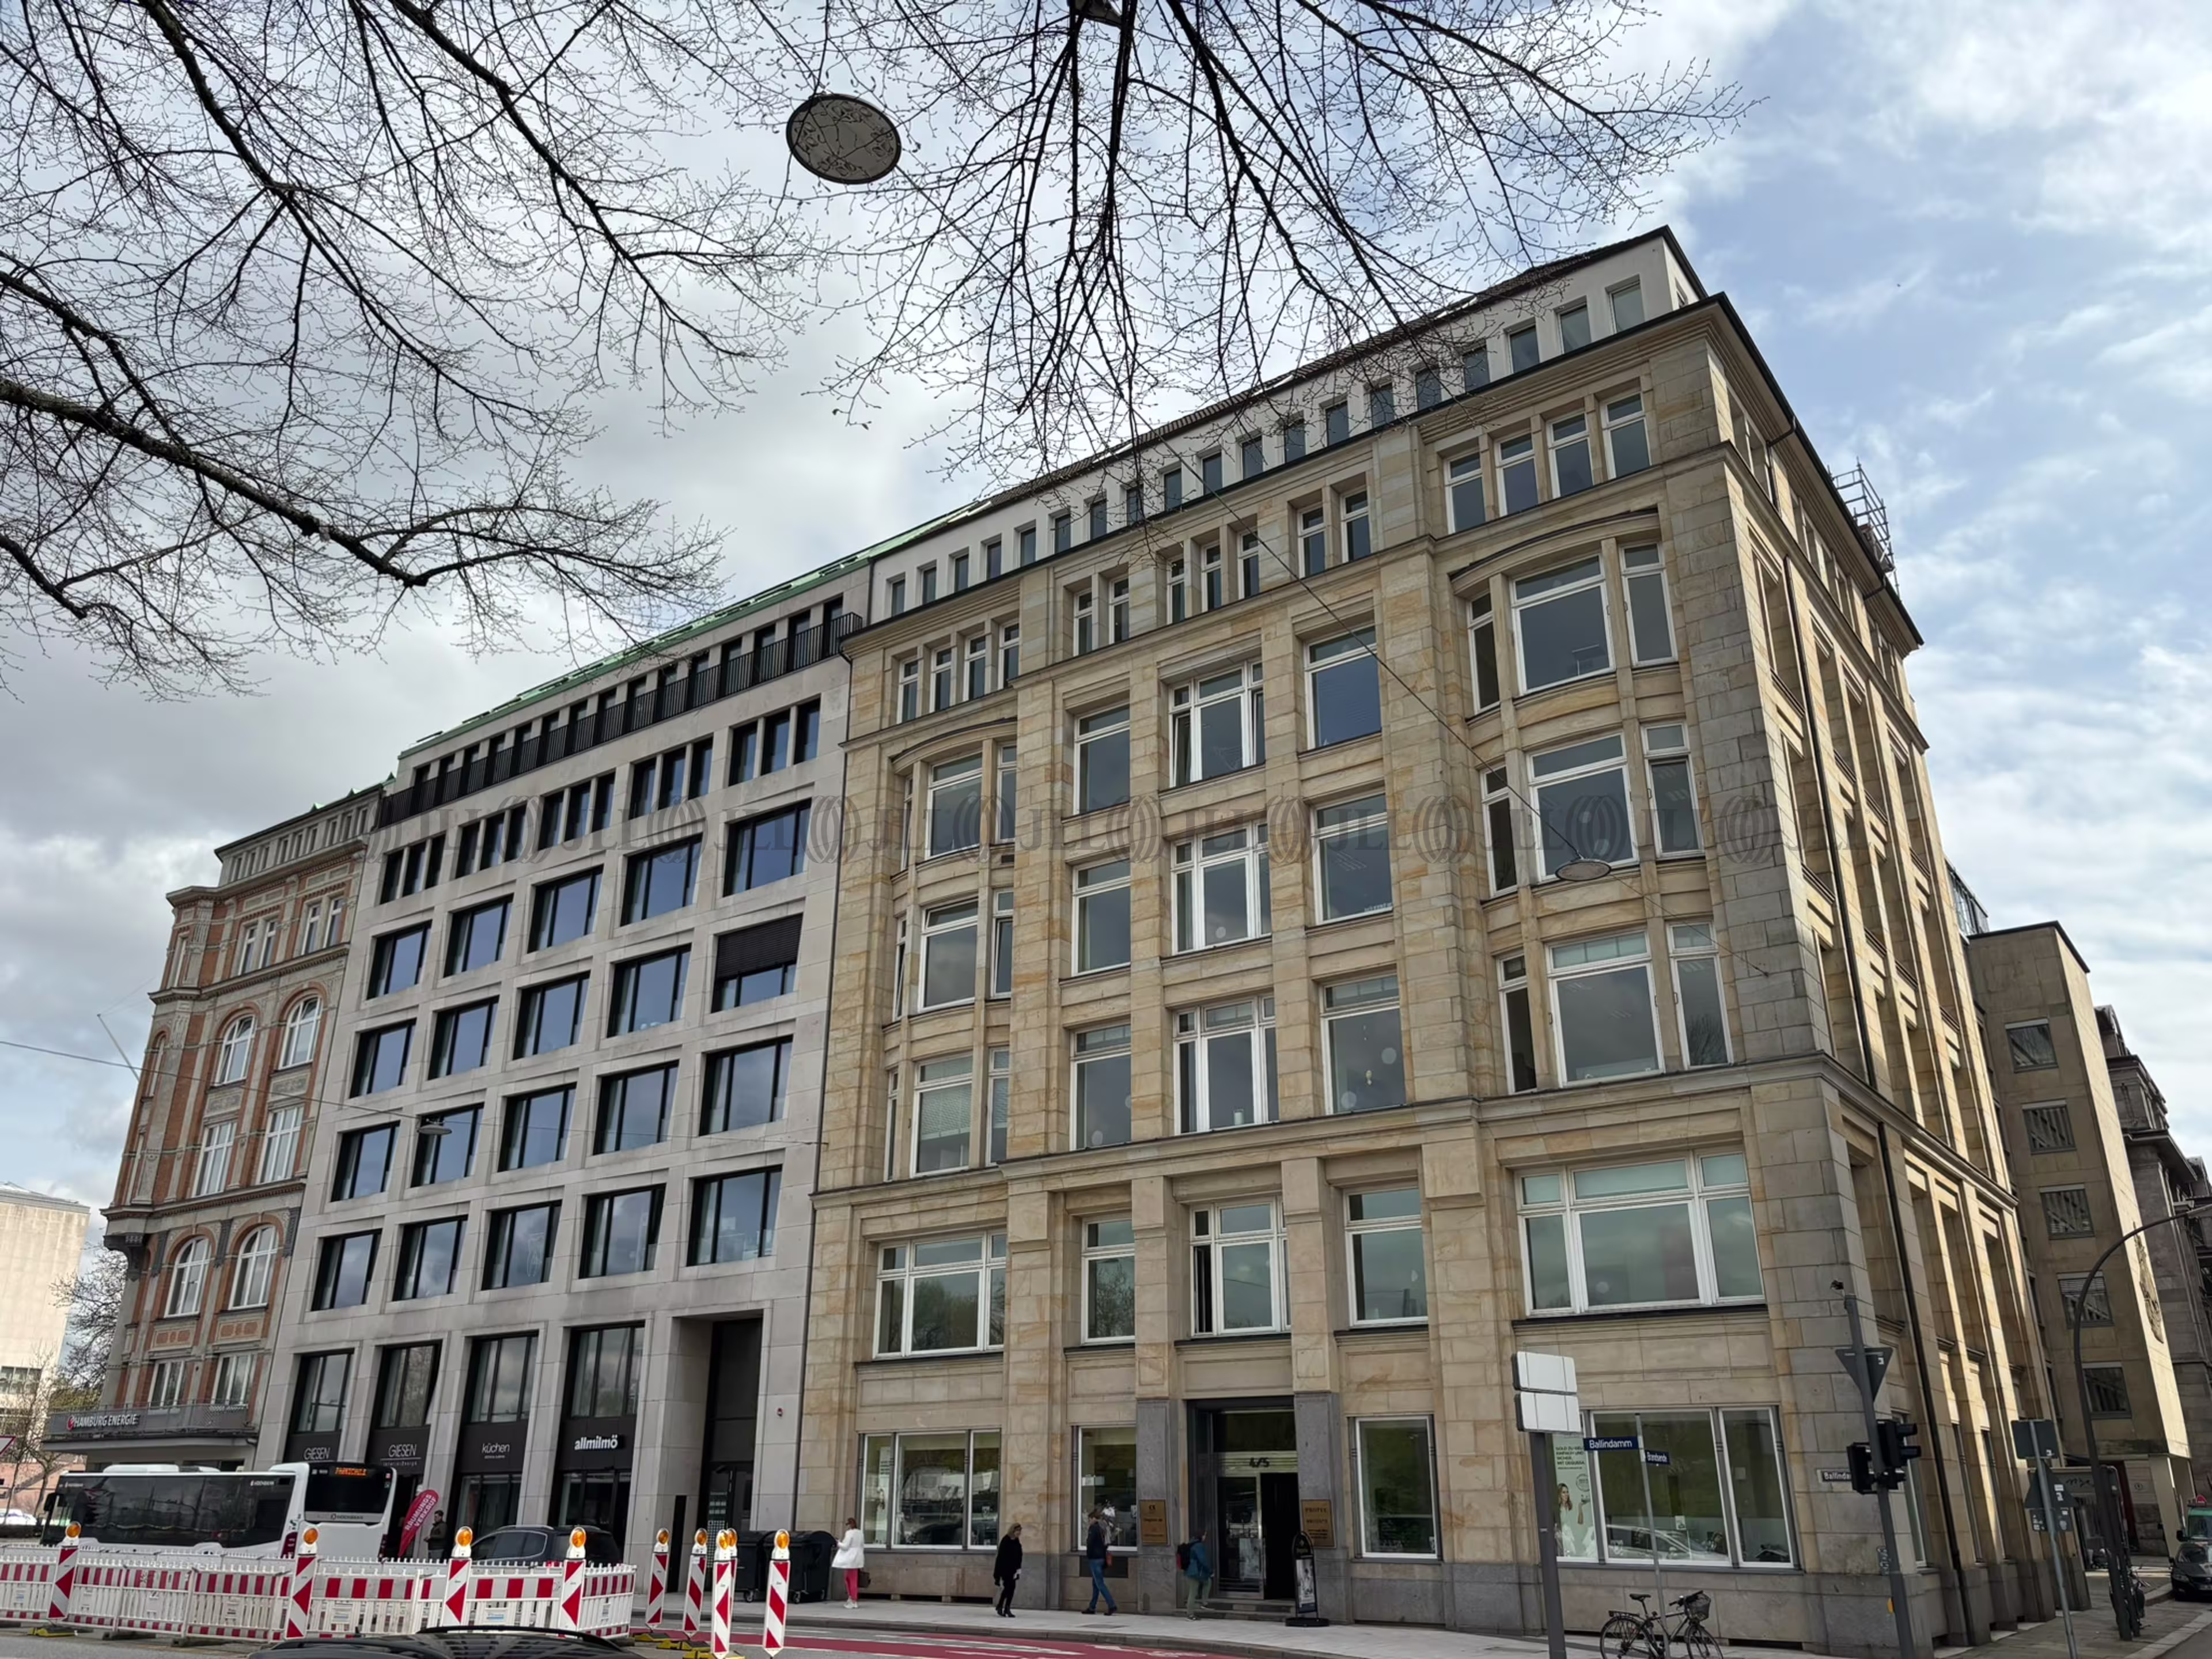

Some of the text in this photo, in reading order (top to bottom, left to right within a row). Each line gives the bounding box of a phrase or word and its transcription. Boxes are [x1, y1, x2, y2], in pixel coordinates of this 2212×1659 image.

[74, 1414, 138, 1427] HAMBURG ENERGIE
[482, 1442, 510, 1453] küchen
[574, 1434, 618, 1450] allmilmö
[1589, 1440, 1633, 1449] Ballindamm
[304, 1447, 330, 1460] GIESEN
[388, 1444, 417, 1457] GIESEN
[1249, 1457, 1270, 1468] 4/5
[1824, 1472, 1851, 1480] Ballinda
[414, 1497, 436, 1527] VERKAUF
